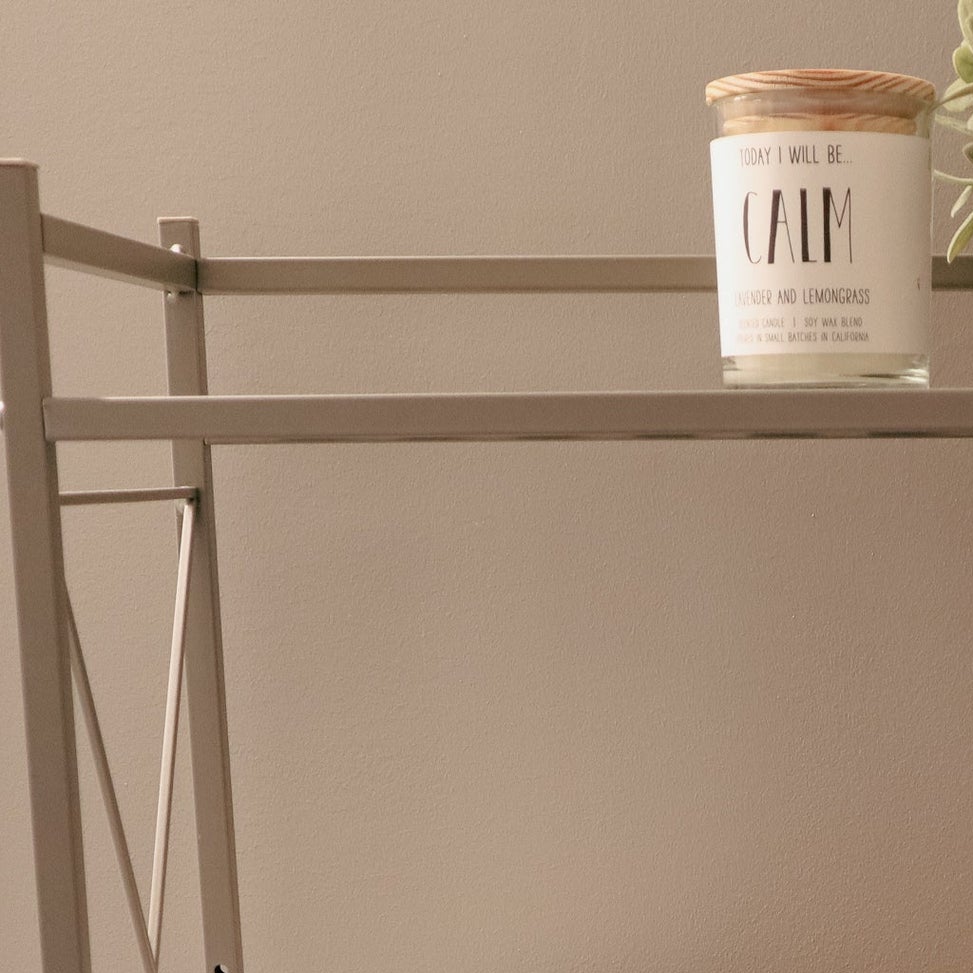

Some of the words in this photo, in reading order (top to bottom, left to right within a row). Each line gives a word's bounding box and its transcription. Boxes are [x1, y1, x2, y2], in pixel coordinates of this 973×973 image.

[740, 147, 771, 166] TODAY
[778, 146, 782, 164] I
[789, 145, 819, 164] WILL
[743, 187, 853, 265] CALM
[777, 287, 797, 305] AND
[802, 287, 870, 305] LEMONGRASS
[822, 316, 838, 328] WAX
[841, 316, 863, 328] BLEND
[788, 331, 817, 342] BATCHES
[831, 331, 869, 342] CALIFORNIA
